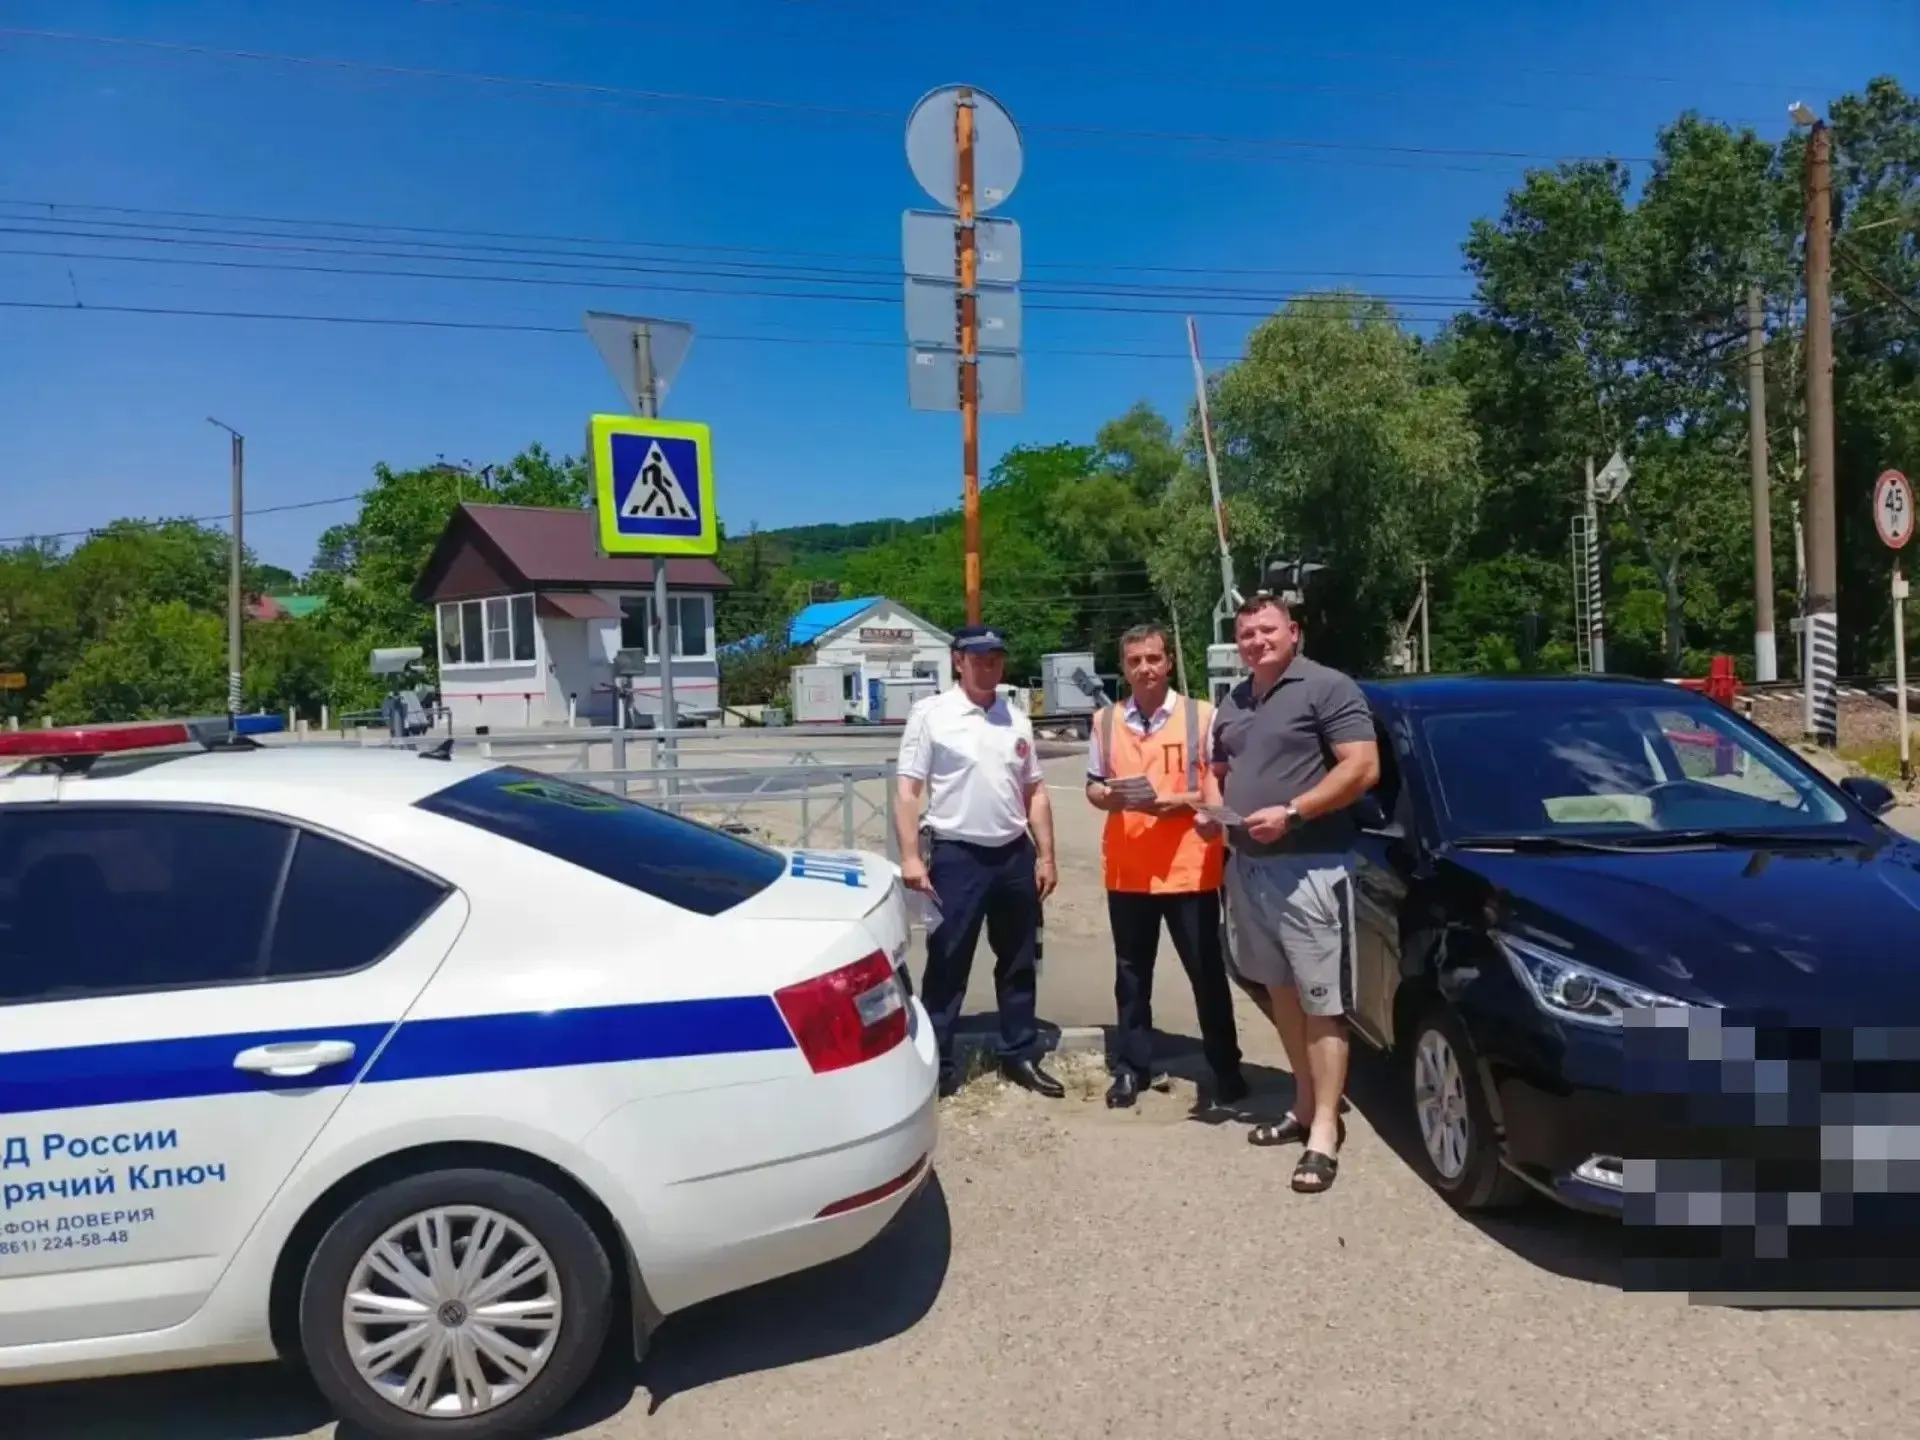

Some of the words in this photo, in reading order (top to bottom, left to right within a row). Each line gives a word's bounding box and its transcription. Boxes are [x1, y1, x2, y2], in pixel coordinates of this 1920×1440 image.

[1162, 743, 1184, 774] П
[0, 1137, 30, 1169] Д
[43, 1128, 178, 1161] России
[3, 1168, 115, 1210] рячий
[128, 1163, 226, 1191] Ключ
[0, 1219, 49, 1236] ФОН
[56, 1207, 155, 1232] ДОВЕРИЯ
[43, 1230, 129, 1251] 224-58-48
